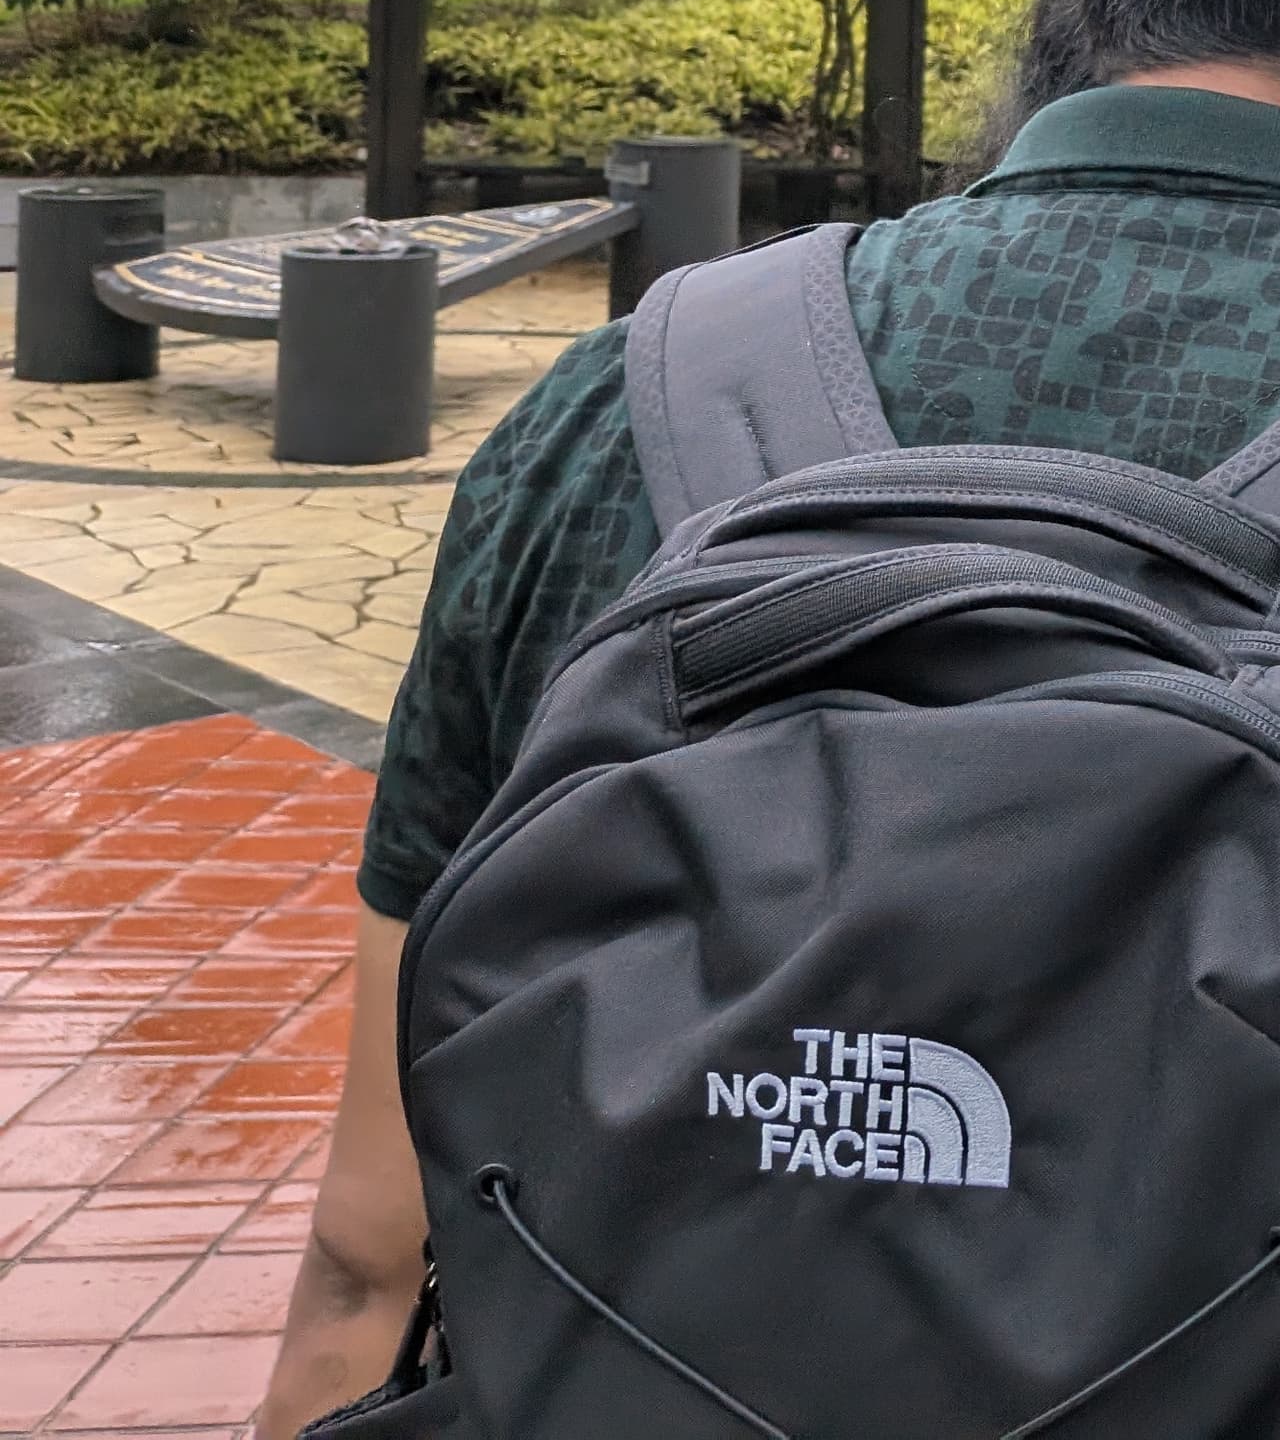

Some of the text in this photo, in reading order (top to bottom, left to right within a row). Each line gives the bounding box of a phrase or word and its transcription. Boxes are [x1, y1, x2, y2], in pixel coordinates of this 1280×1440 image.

[793, 1028, 907, 1082] THE
[706, 1072, 904, 1132] NORTH
[759, 1123, 902, 1182] FACE
